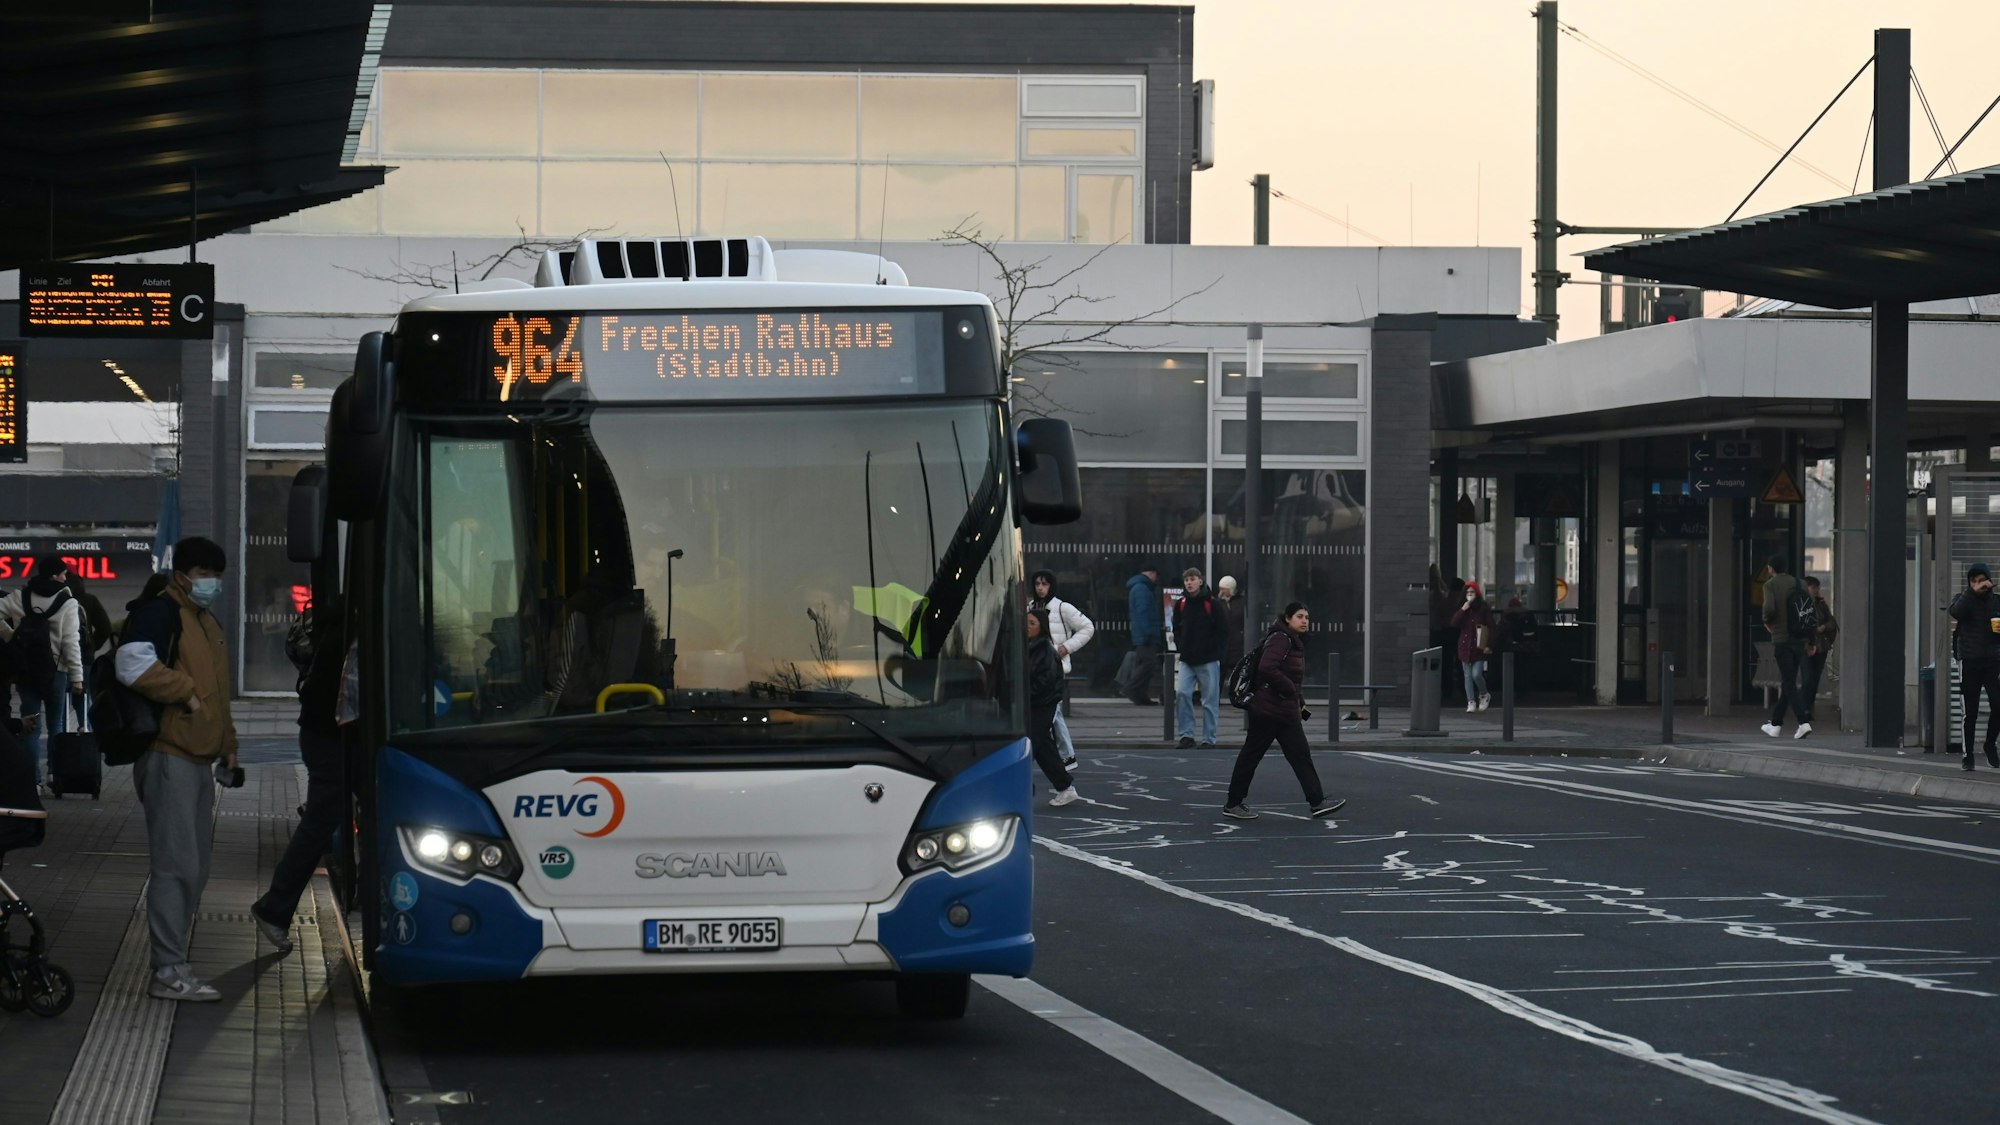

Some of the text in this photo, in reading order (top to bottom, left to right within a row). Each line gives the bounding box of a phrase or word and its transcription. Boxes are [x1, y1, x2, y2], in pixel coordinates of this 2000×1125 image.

[29, 277, 171, 287] Linie Ziel Abfahrt
[180, 294, 204, 323] C
[492, 313, 893, 385] 964 Frechen Rathaus
[656, 351, 840, 379] (Stadtbahn)
[1716, 478, 1745, 488] Ausgang
[56, 541, 101, 551] SCHNITZEL
[126, 541, 150, 551] PIZZA
[1450, 760, 1745, 778] BUS
[513, 794, 598, 818] REVG
[539, 852, 566, 865] VRS
[635, 852, 788, 879] SCANIA
[659, 923, 684, 944] BM
[698, 923, 723, 944] RE
[728, 922, 776, 944] 9055
